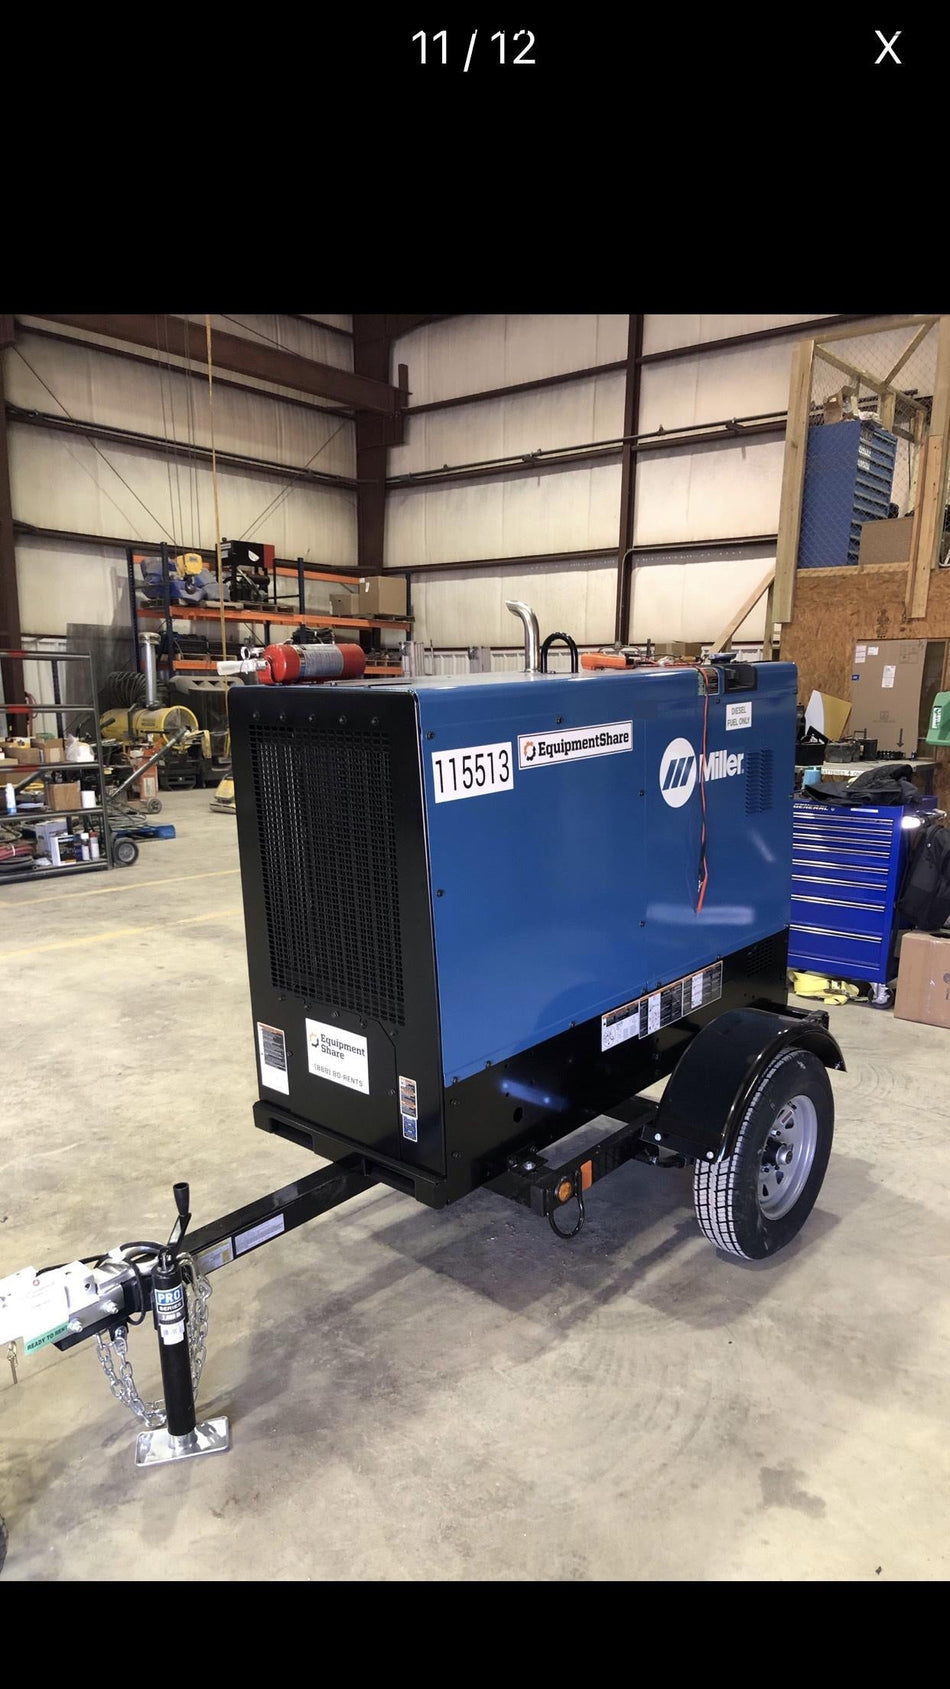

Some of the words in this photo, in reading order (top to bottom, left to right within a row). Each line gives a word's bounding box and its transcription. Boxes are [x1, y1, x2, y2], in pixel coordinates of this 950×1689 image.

[731, 706, 747, 716] DIESEL
[727, 718, 738, 727] FUEL
[738, 717, 750, 726] ONLY
[537, 731, 630, 759] EquipmentShare
[434, 749, 510, 794] 115513
[698, 749, 744, 783] Miller
[320, 1033, 366, 1057] Equipment
[320, 1044, 345, 1060] Share
[157, 1289, 181, 1304] PRO
[27, 1337, 46, 1351] READY
[46, 1332, 54, 1340] TO
